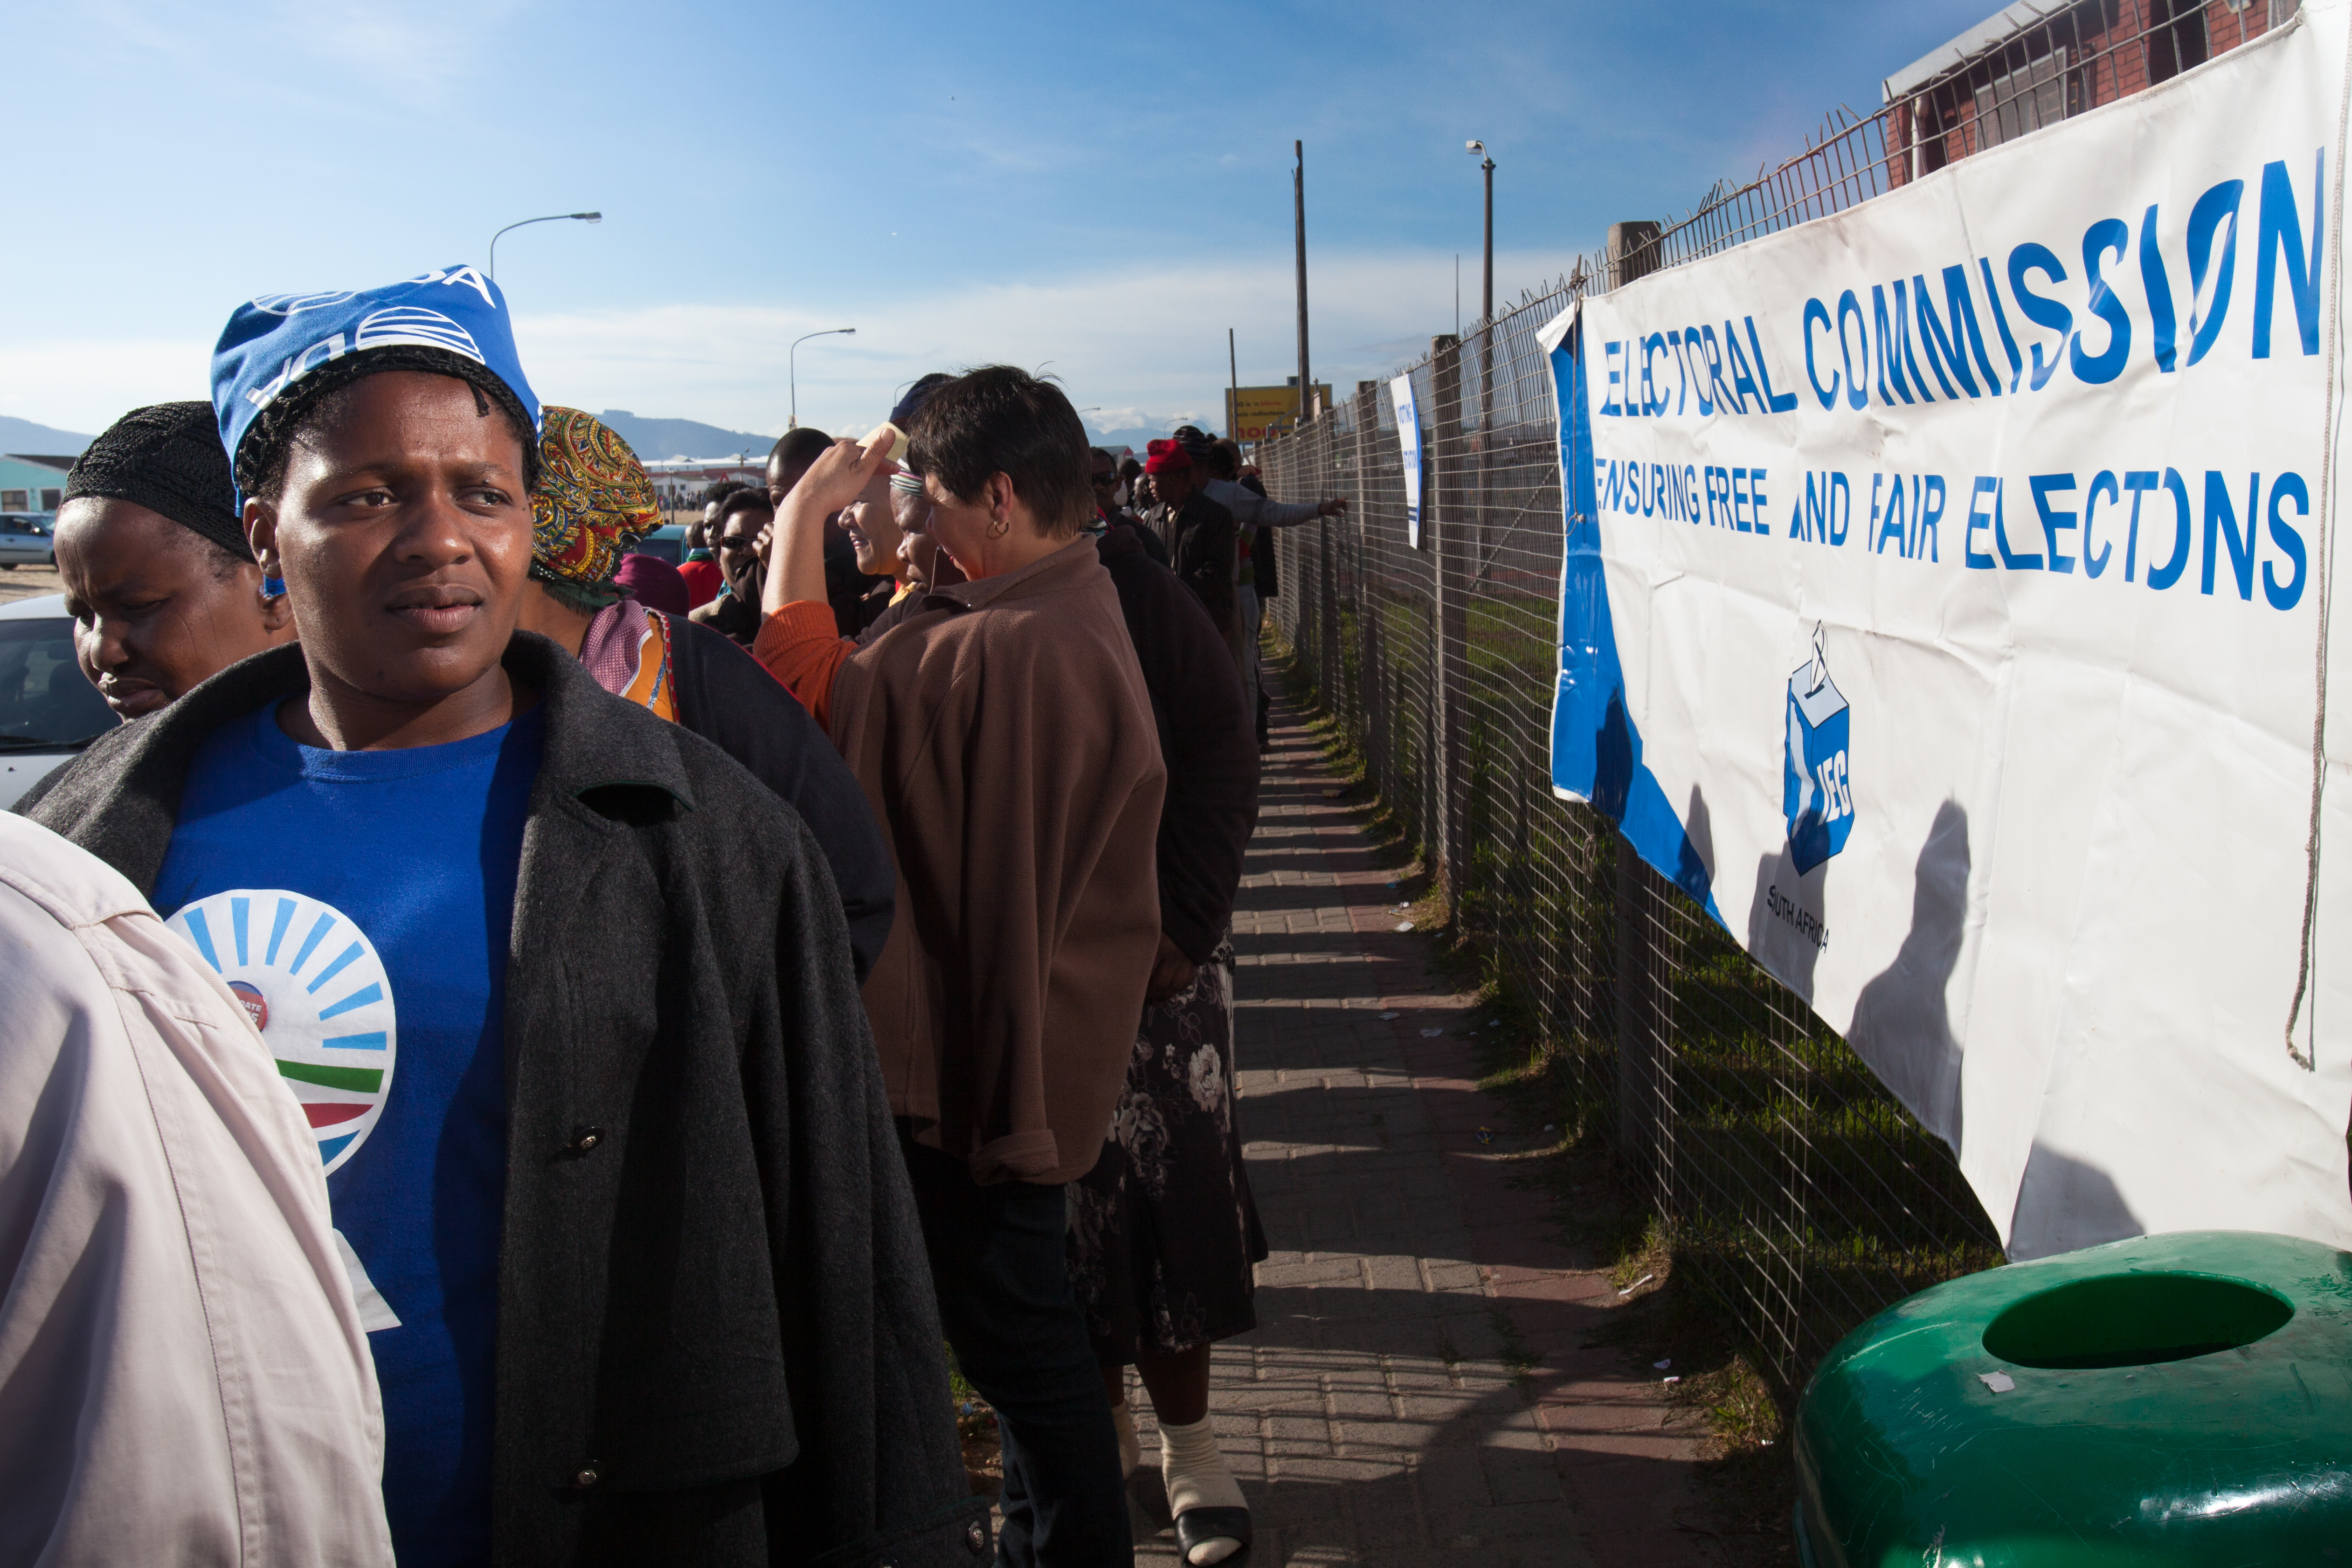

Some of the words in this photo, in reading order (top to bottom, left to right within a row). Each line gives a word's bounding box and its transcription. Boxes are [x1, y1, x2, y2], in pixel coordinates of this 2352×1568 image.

[1599, 315, 1799, 418] ELECTORAL
[1803, 146, 2324, 411] COMMISSION
[1595, 458, 1701, 525] ENSURING
[1704, 465, 1770, 536] FREE
[1868, 472, 1946, 564] FAIR
[1965, 467, 2310, 611] ELECTONS
[1817, 750, 1851, 826] IEC
[1795, 907, 1829, 954] AFRICA
